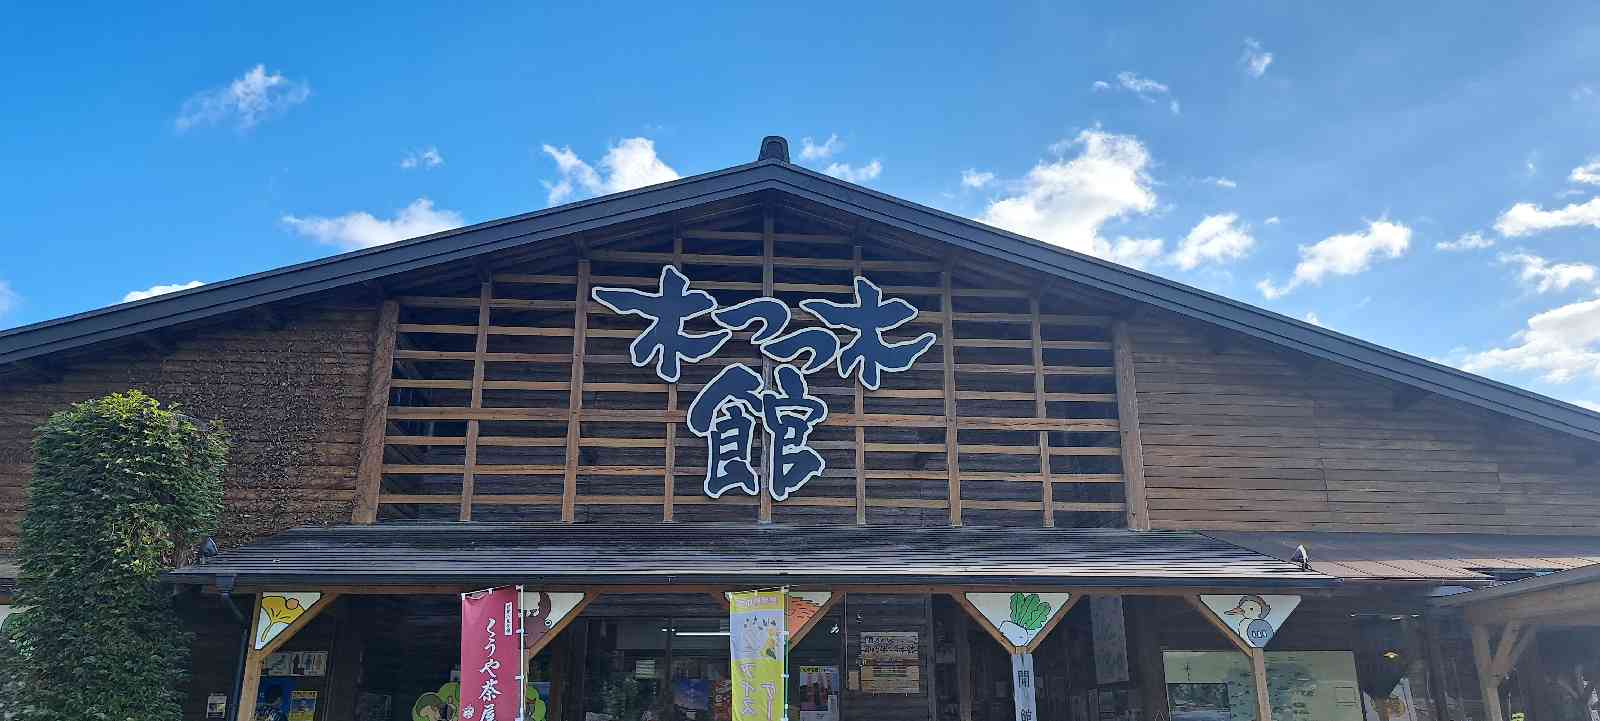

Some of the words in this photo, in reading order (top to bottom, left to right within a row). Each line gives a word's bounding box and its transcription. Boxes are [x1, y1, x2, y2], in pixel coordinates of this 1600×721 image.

[592, 264, 937, 391] 木つつ木
[686, 363, 828, 500] 館
